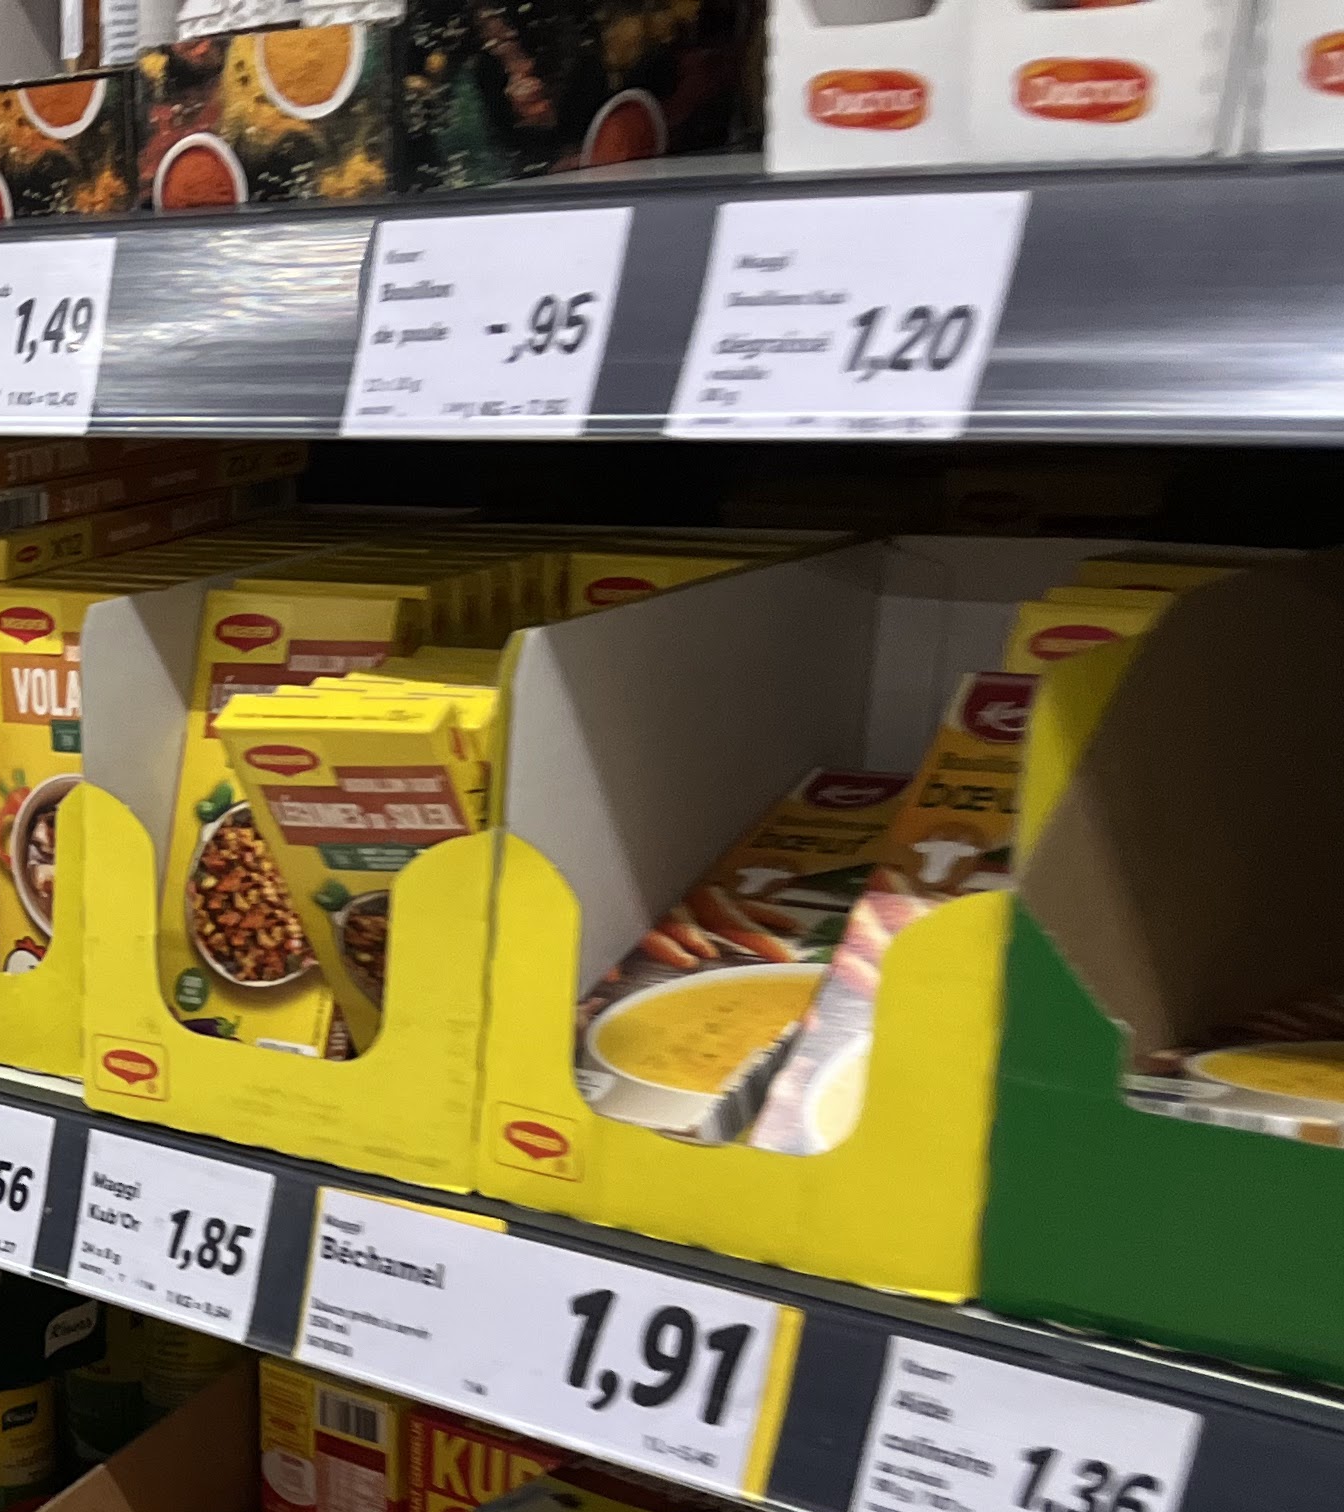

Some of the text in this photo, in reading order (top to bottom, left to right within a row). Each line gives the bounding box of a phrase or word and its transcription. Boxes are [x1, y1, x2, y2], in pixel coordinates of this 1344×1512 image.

[15, 297, 94, 364] 1,49
[485, 292, 596, 364] -,95
[839, 303, 976, 383] 1,20
[12, 667, 82, 717] VOLA
[91, 1171, 141, 1201] Maggi
[169, 1209, 254, 1276] 1,85
[320, 1234, 447, 1290] Béchamel
[567, 1288, 756, 1427] 1,91
